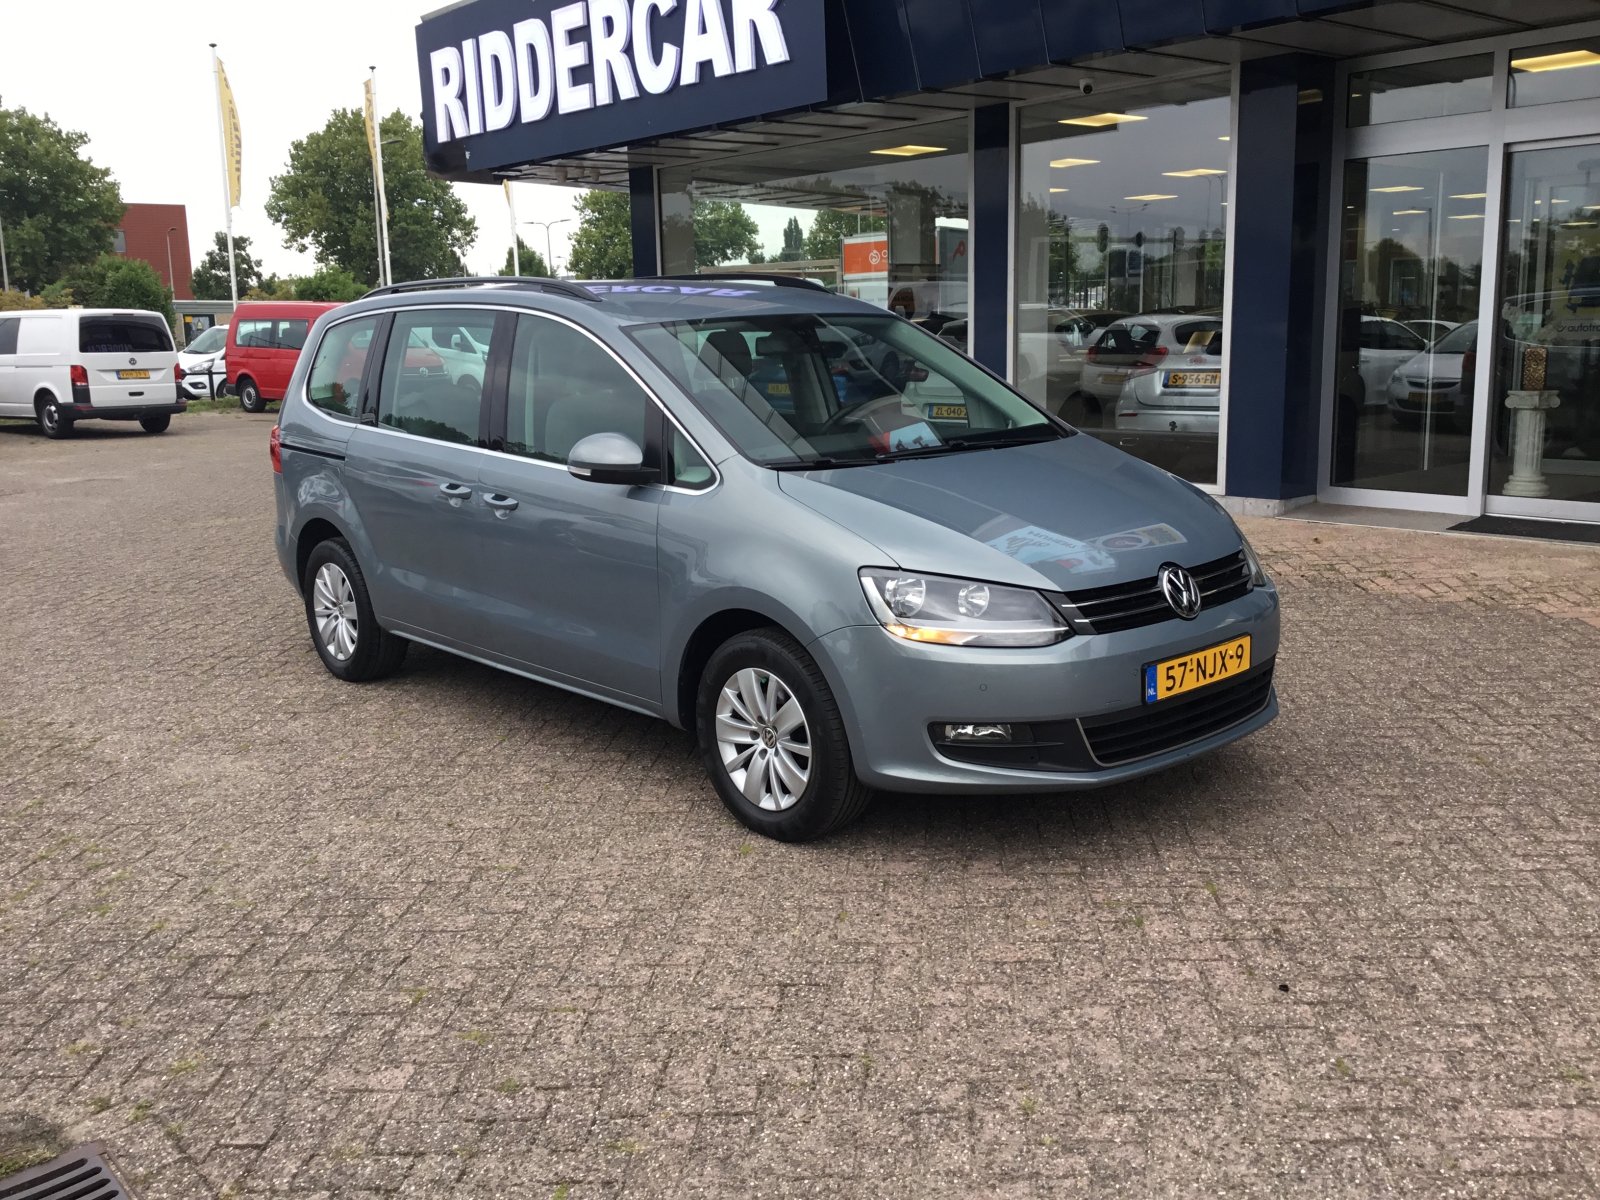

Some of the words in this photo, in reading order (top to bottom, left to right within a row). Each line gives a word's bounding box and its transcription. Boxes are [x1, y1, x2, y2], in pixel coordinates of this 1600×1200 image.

[429, 0, 791, 143] RIDDERCAR
[1147, 686, 1157, 697] NL
[1165, 643, 1245, 692] 57-NJX-9
